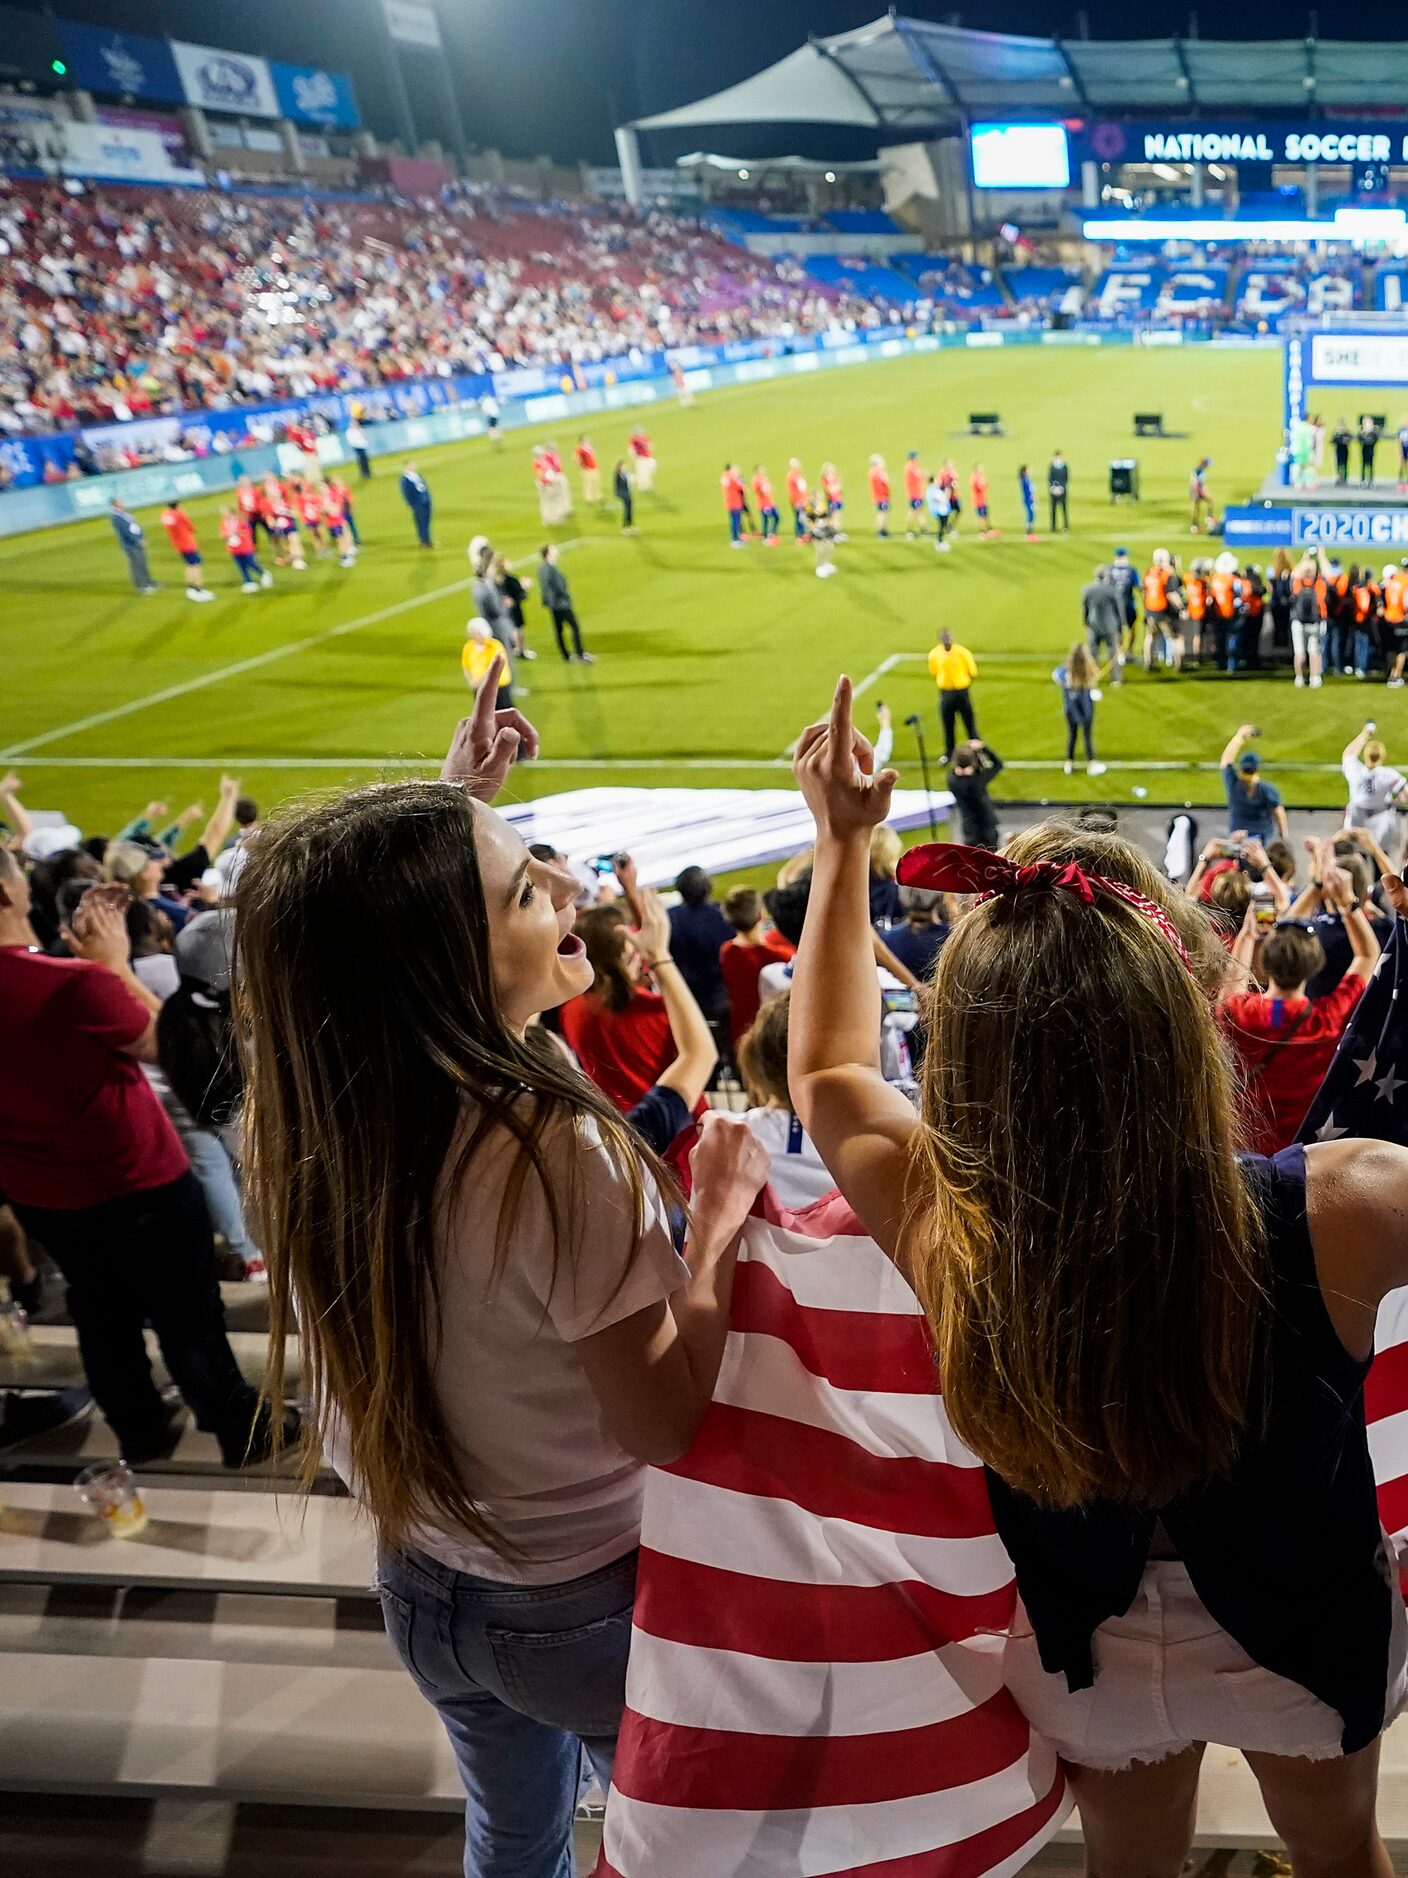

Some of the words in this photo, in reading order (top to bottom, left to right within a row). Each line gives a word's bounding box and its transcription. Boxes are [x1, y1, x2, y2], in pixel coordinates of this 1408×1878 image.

[1143, 133, 1274, 161] NATIONAL
[1284, 133, 1391, 162] SOCCER
[1304, 512, 1371, 541] 2020
